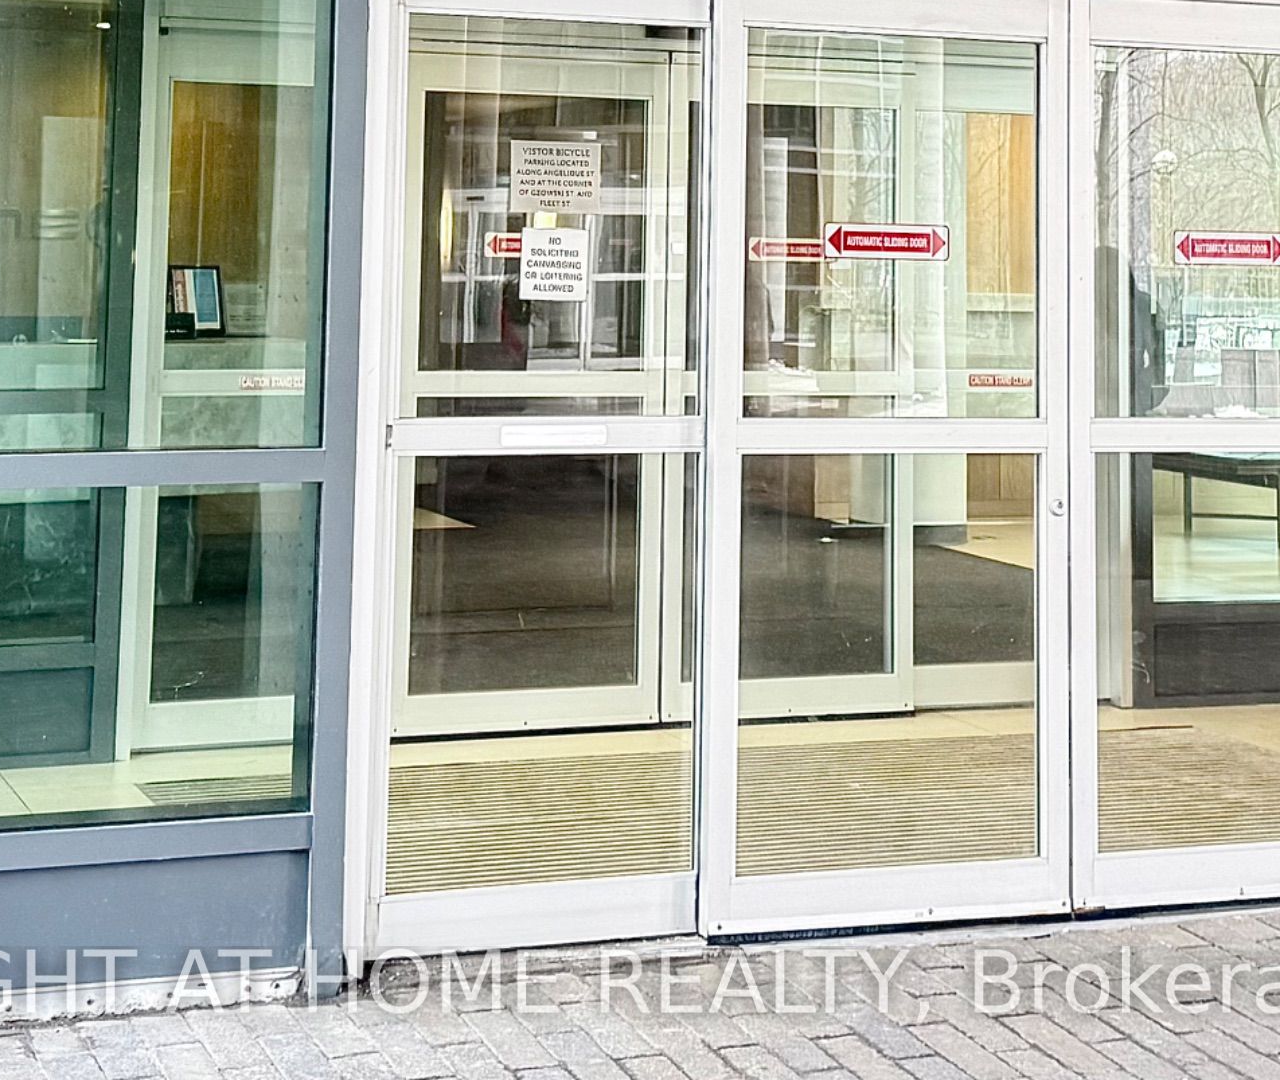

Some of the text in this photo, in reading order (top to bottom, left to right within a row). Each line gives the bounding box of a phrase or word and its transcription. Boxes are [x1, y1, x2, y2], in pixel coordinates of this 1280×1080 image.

[556, 148, 590, 157] BICYCLE
[557, 159, 590, 168] LOCATED
[520, 179, 536, 187] AND
[563, 180, 593, 188] CORNER
[561, 200, 571, 208] ST
[548, 237, 561, 245] NO
[846, 236, 928, 248] AUTOMATIC SLIDING DOOR
[1194, 243, 1227, 254] AUTOMATIC
[524, 271, 538, 280] OR
[532, 283, 574, 293] ALLOWED
